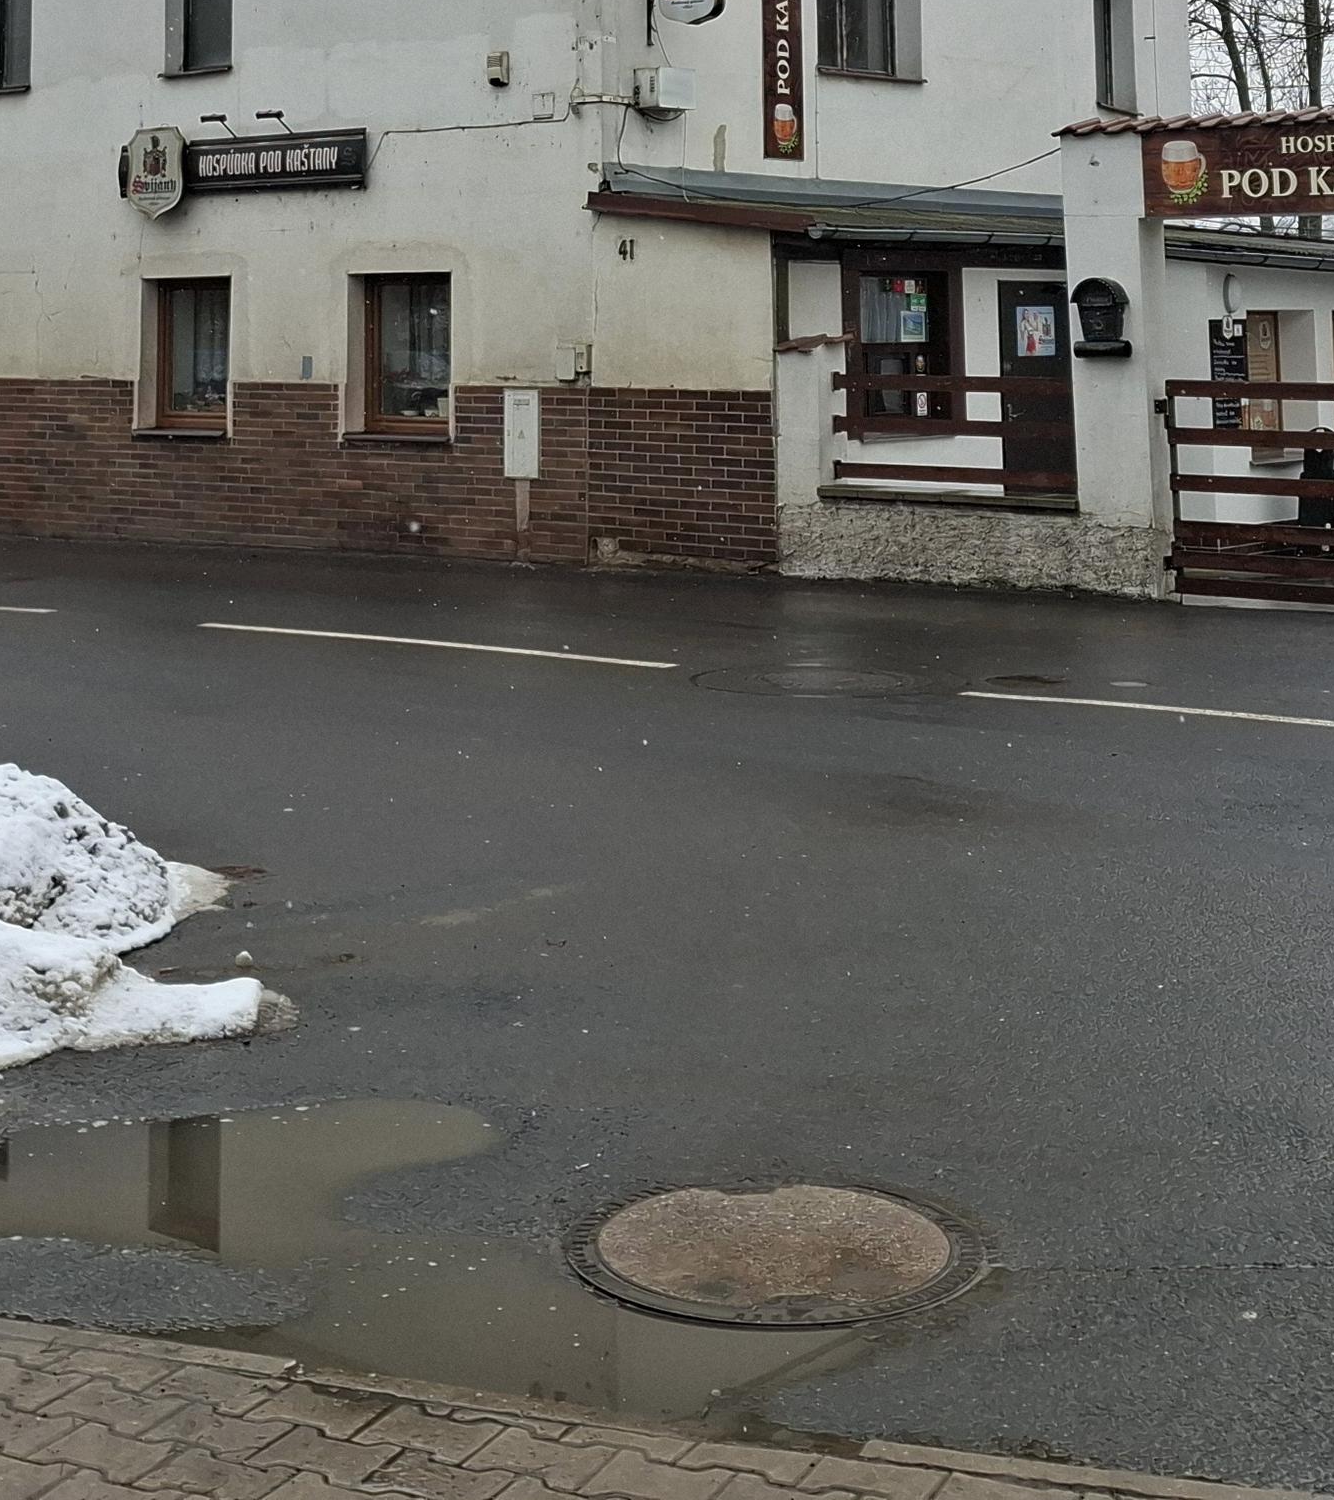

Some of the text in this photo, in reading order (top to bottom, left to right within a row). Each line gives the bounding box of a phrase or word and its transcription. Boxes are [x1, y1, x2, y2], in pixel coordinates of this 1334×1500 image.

[777, 38, 790, 95] POD
[260, 150, 282, 173] POD
[286, 145, 338, 172] KAŠTANY
[132, 175, 177, 195] Svijany
[1220, 168, 1298, 198] POD
[619, 239, 635, 260] 41
